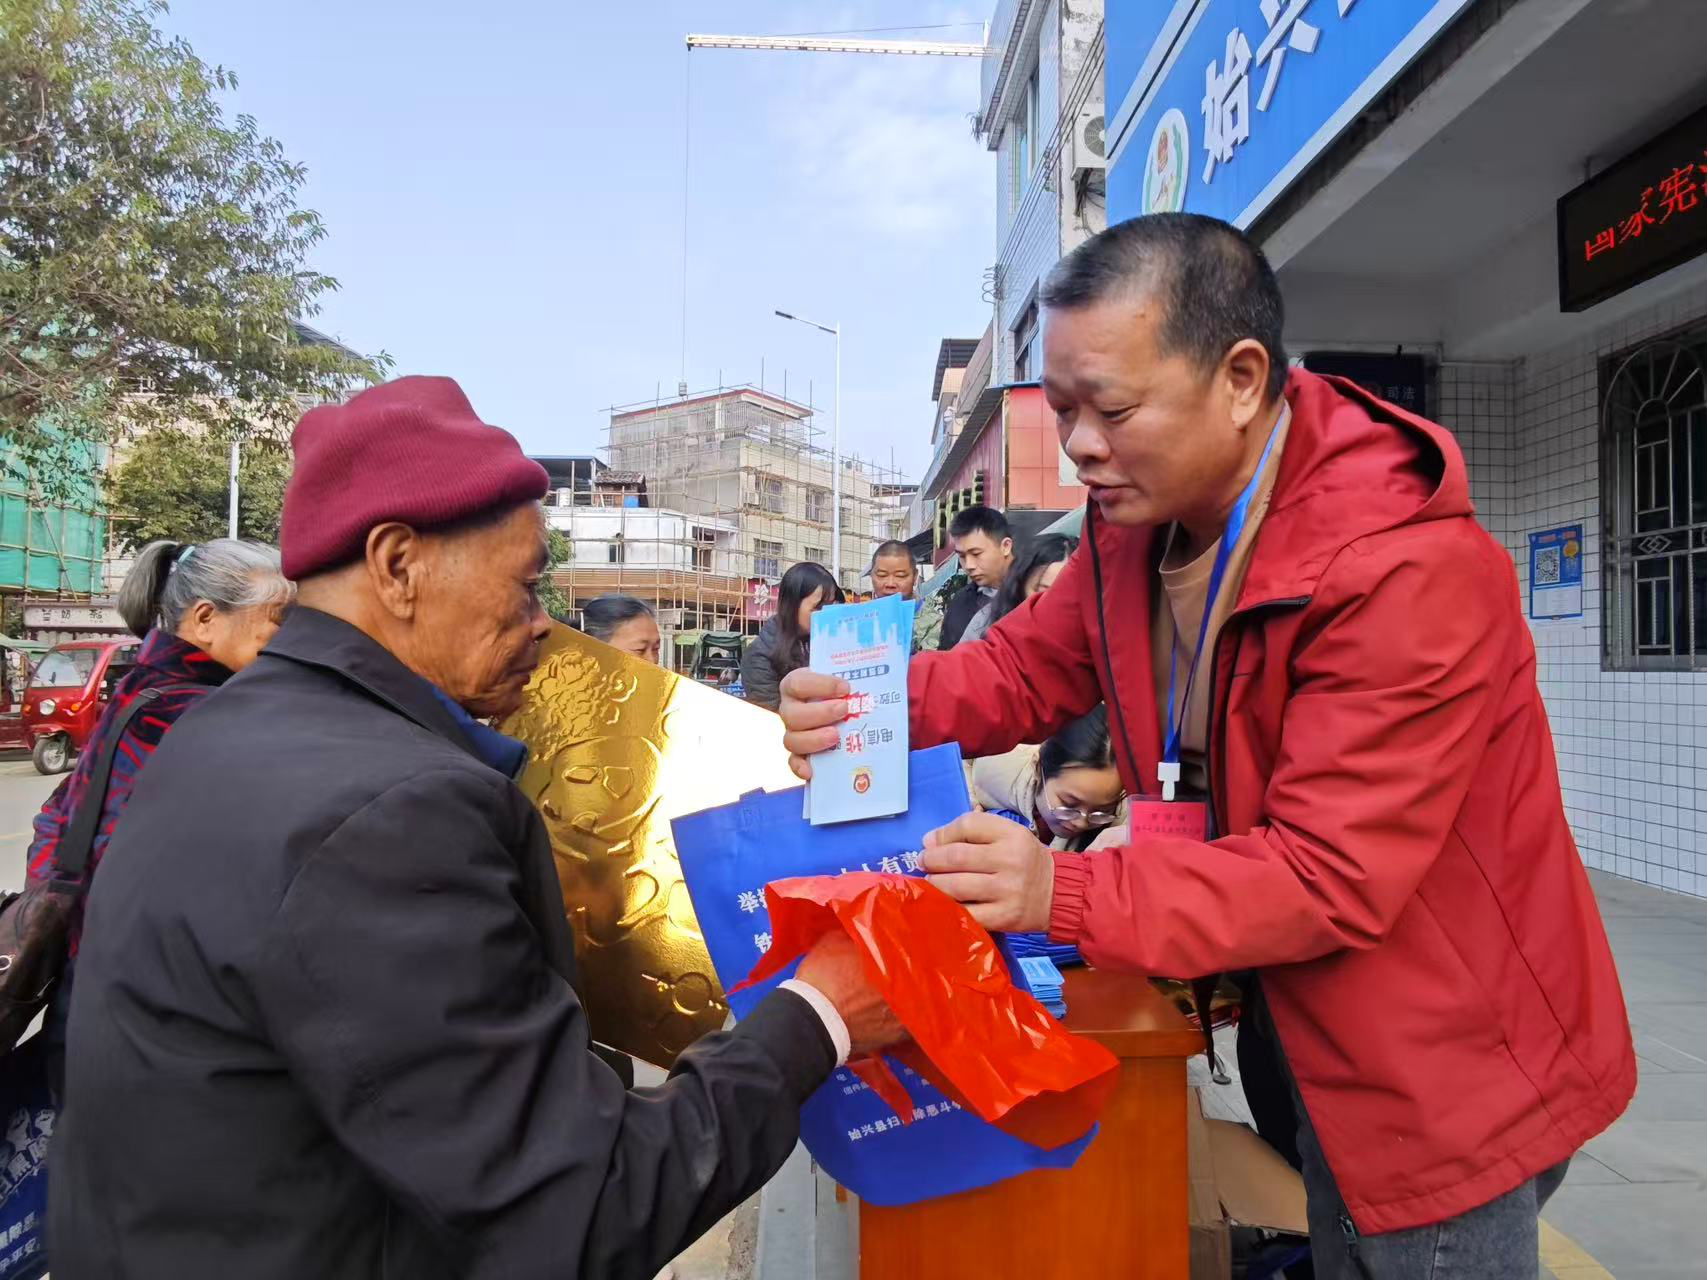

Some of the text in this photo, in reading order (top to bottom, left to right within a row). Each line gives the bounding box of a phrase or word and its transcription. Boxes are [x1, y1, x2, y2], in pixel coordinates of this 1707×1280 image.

[1202, 0, 1356, 184] 始兴
[847, 1100, 961, 1141] 始兴县扫除恶斗
